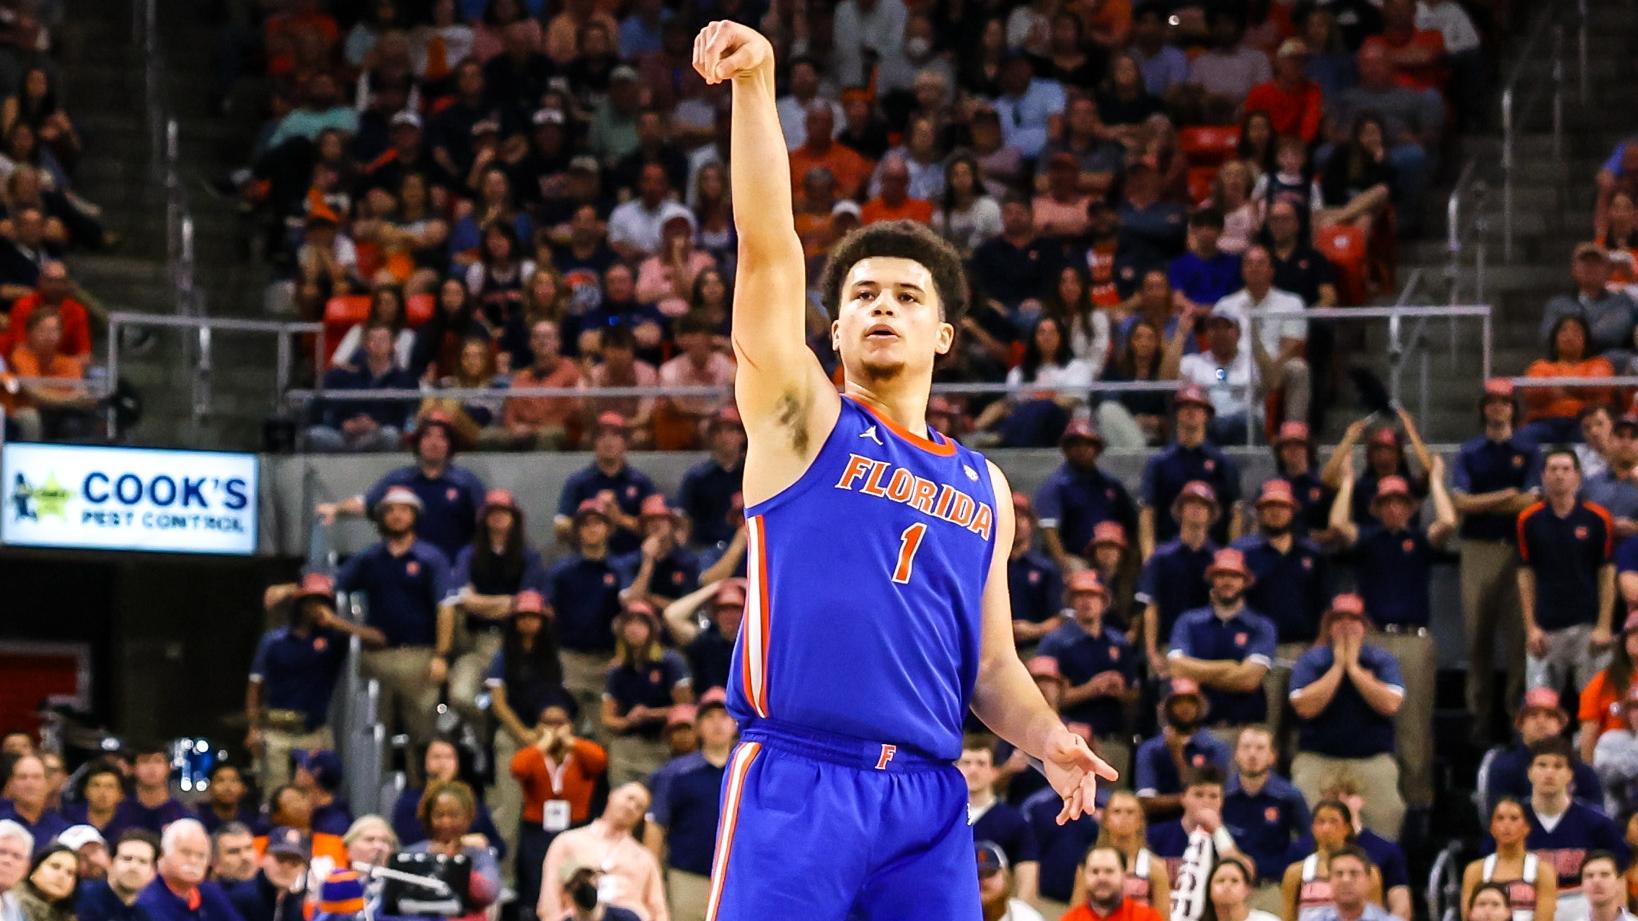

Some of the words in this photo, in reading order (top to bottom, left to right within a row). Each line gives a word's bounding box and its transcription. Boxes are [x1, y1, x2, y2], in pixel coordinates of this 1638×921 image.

[84, 472, 248, 510] COOK'S
[835, 453, 993, 541] FLORIDA
[82, 511, 134, 528] PEST
[142, 513, 244, 531] CONTROL
[892, 522, 927, 584] 1
[875, 743, 897, 770] F
